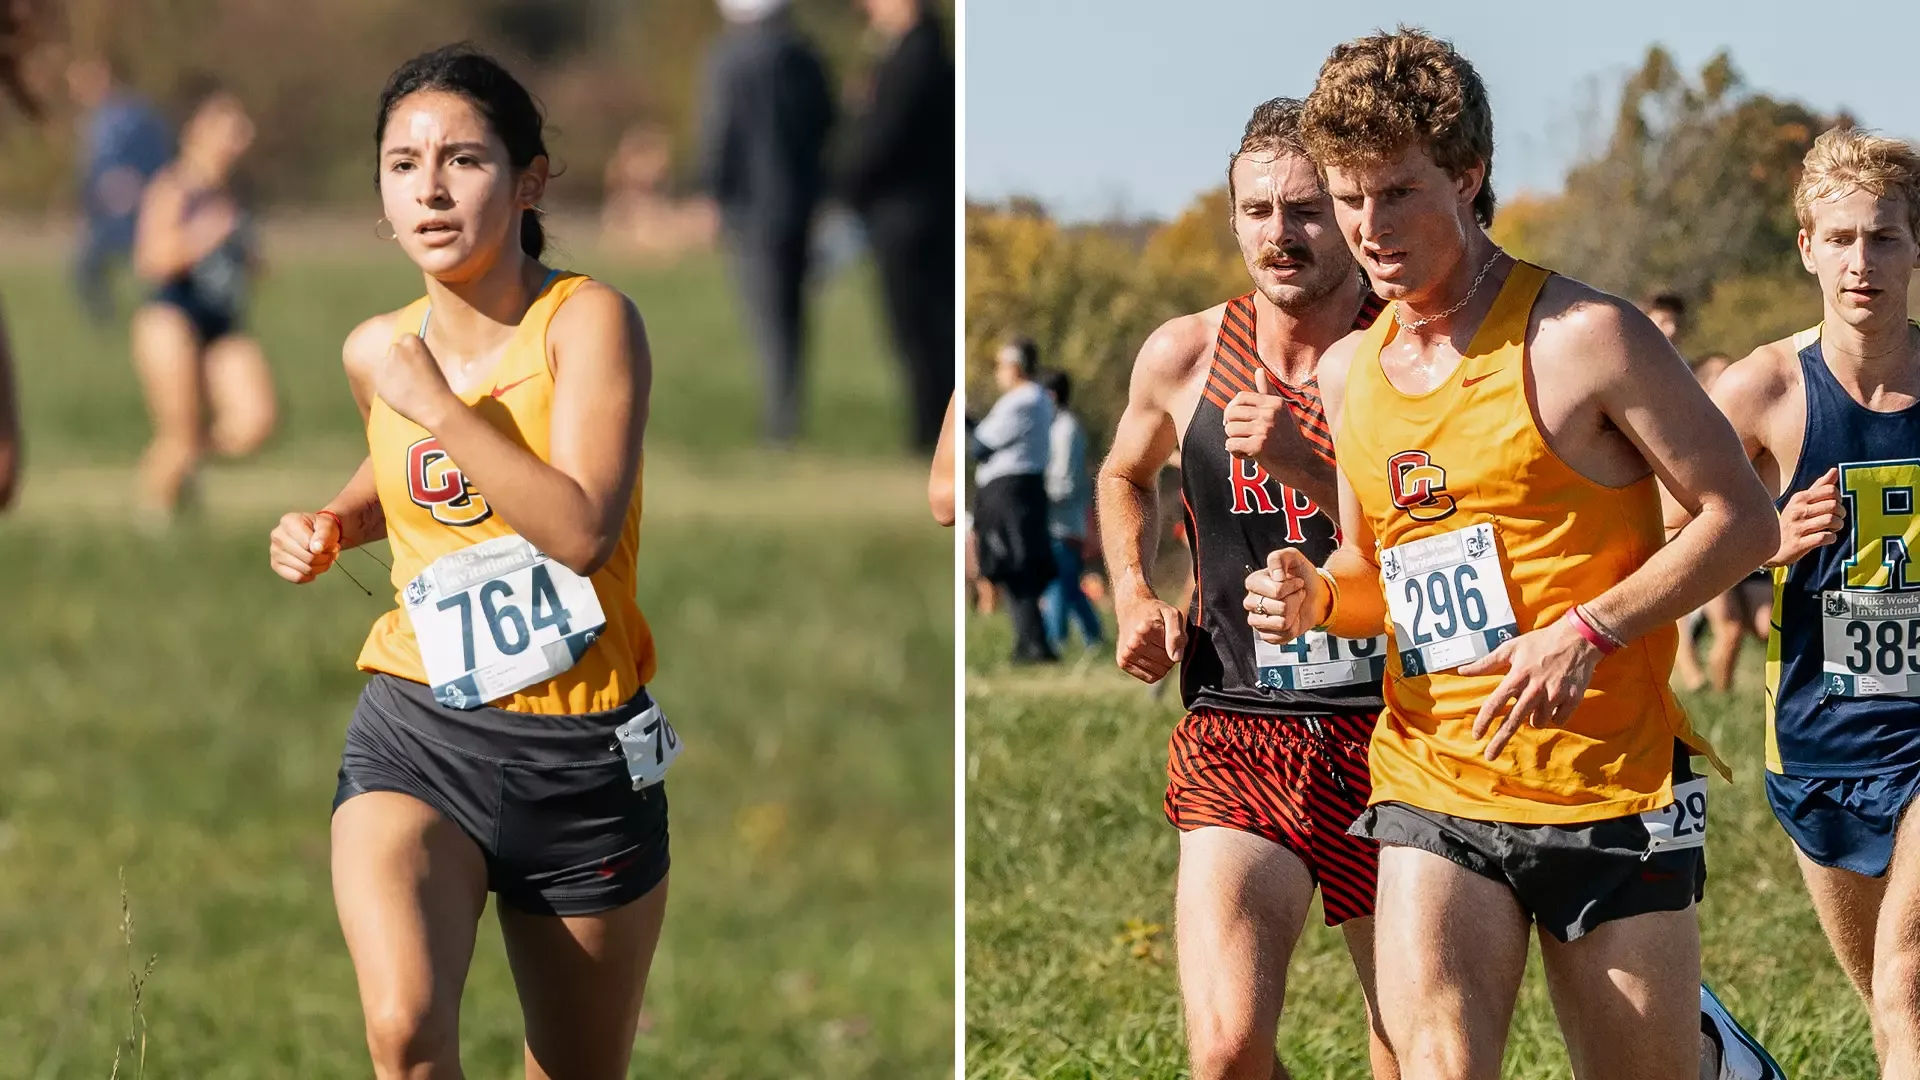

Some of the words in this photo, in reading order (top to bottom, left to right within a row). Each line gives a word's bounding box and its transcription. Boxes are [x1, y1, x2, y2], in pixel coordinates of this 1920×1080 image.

[1225, 450, 1343, 549] RP
[1838, 458, 1920, 592] R
[436, 563, 572, 672] 764
[1405, 564, 1488, 645] 296
[1856, 604, 1920, 617] Invitational
[1859, 596, 1885, 606] Mike
[1886, 594, 1919, 605] Woods
[1662, 791, 1707, 838] 29
